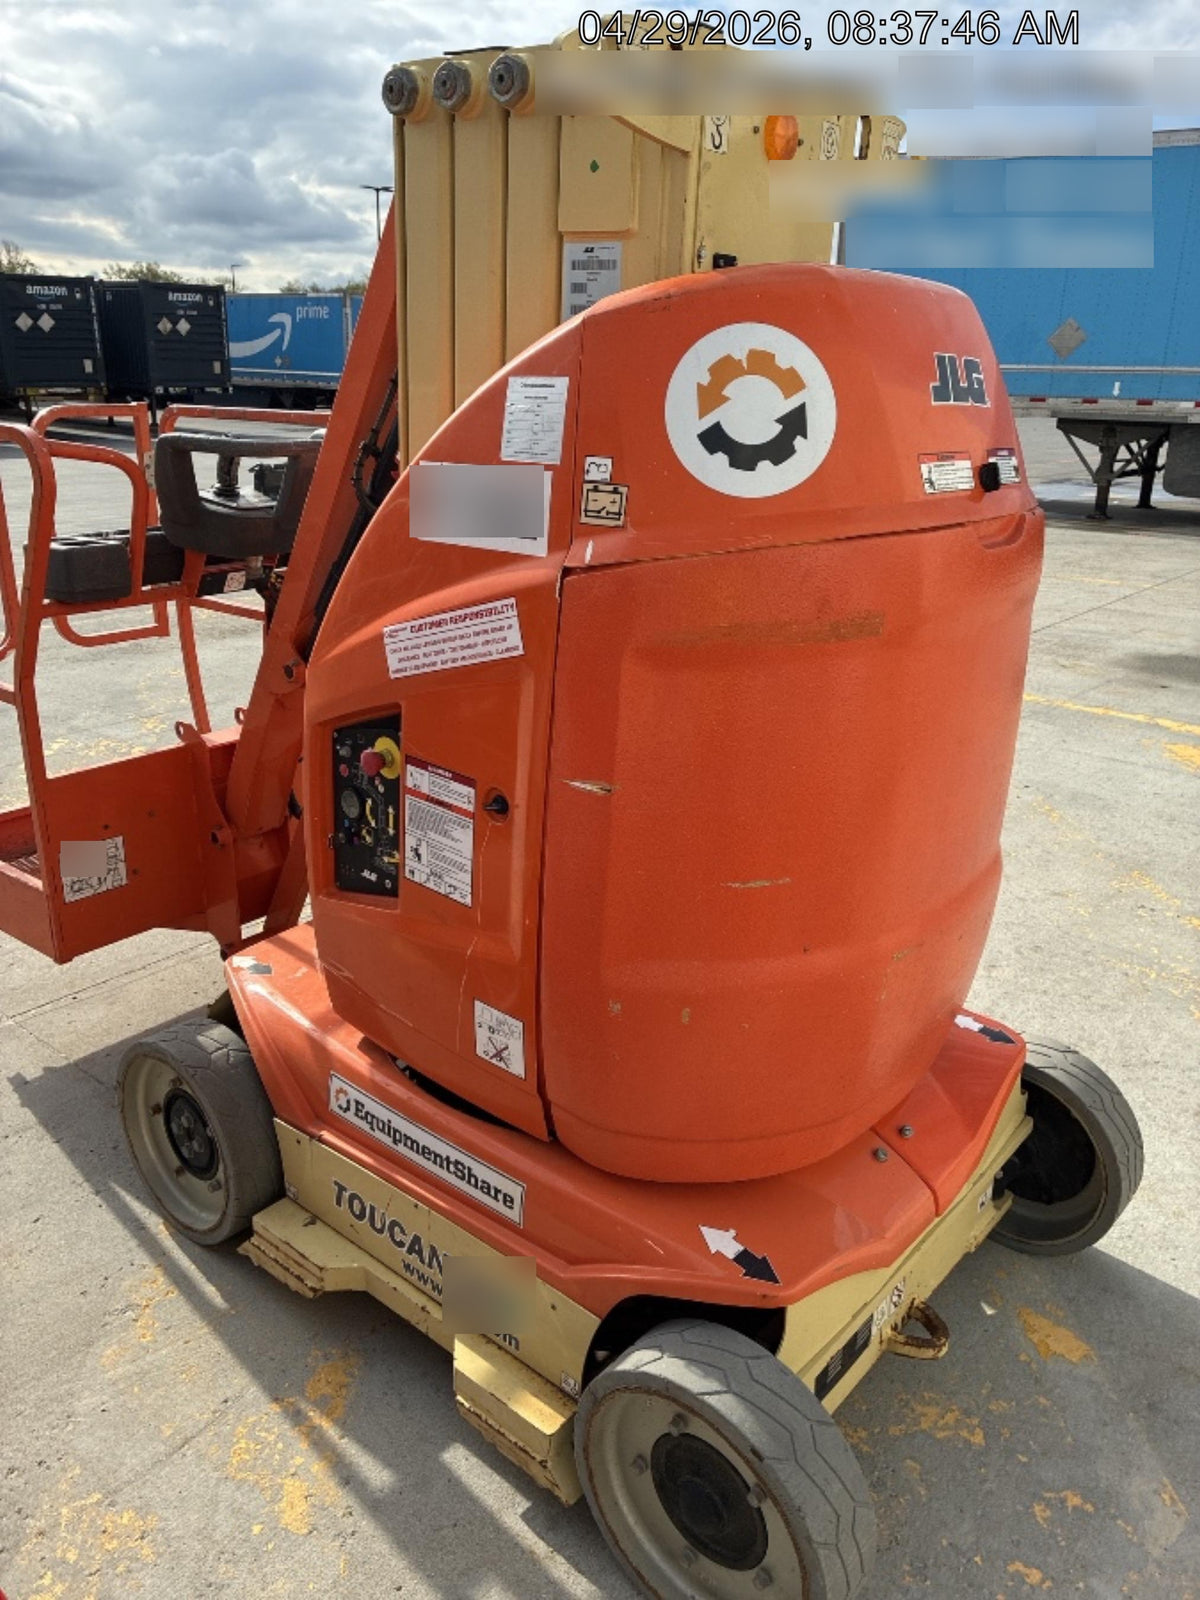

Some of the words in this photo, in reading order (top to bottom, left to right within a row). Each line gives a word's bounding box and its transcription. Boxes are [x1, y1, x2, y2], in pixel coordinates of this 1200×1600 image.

[26, 284, 68, 297] amazon
[168, 291, 203, 303] amazon
[295, 303, 330, 322] prime
[930, 352, 990, 407] JLG
[410, 618, 449, 634] CUSTOMER
[449, 602, 515, 626] RESPONSIBILITY
[353, 1099, 515, 1210] EquipmentShare
[332, 1180, 448, 1277] TOUCAN
